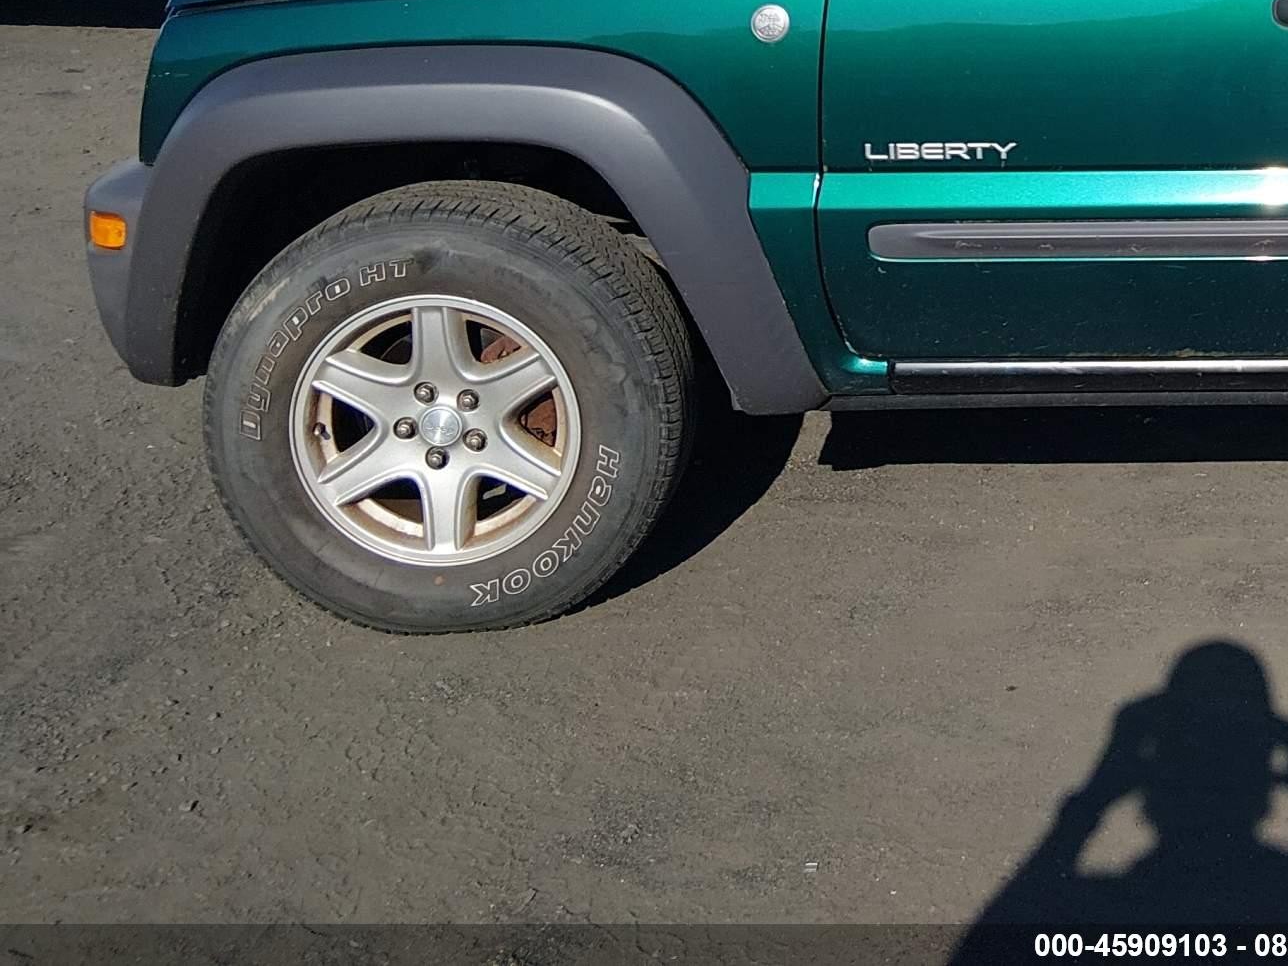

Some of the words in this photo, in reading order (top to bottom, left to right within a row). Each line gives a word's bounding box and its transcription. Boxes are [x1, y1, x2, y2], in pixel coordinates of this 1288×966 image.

[864, 142, 1017, 160] LIBERTY
[239, 277, 351, 441] Dynapro
[359, 259, 415, 287] HT
